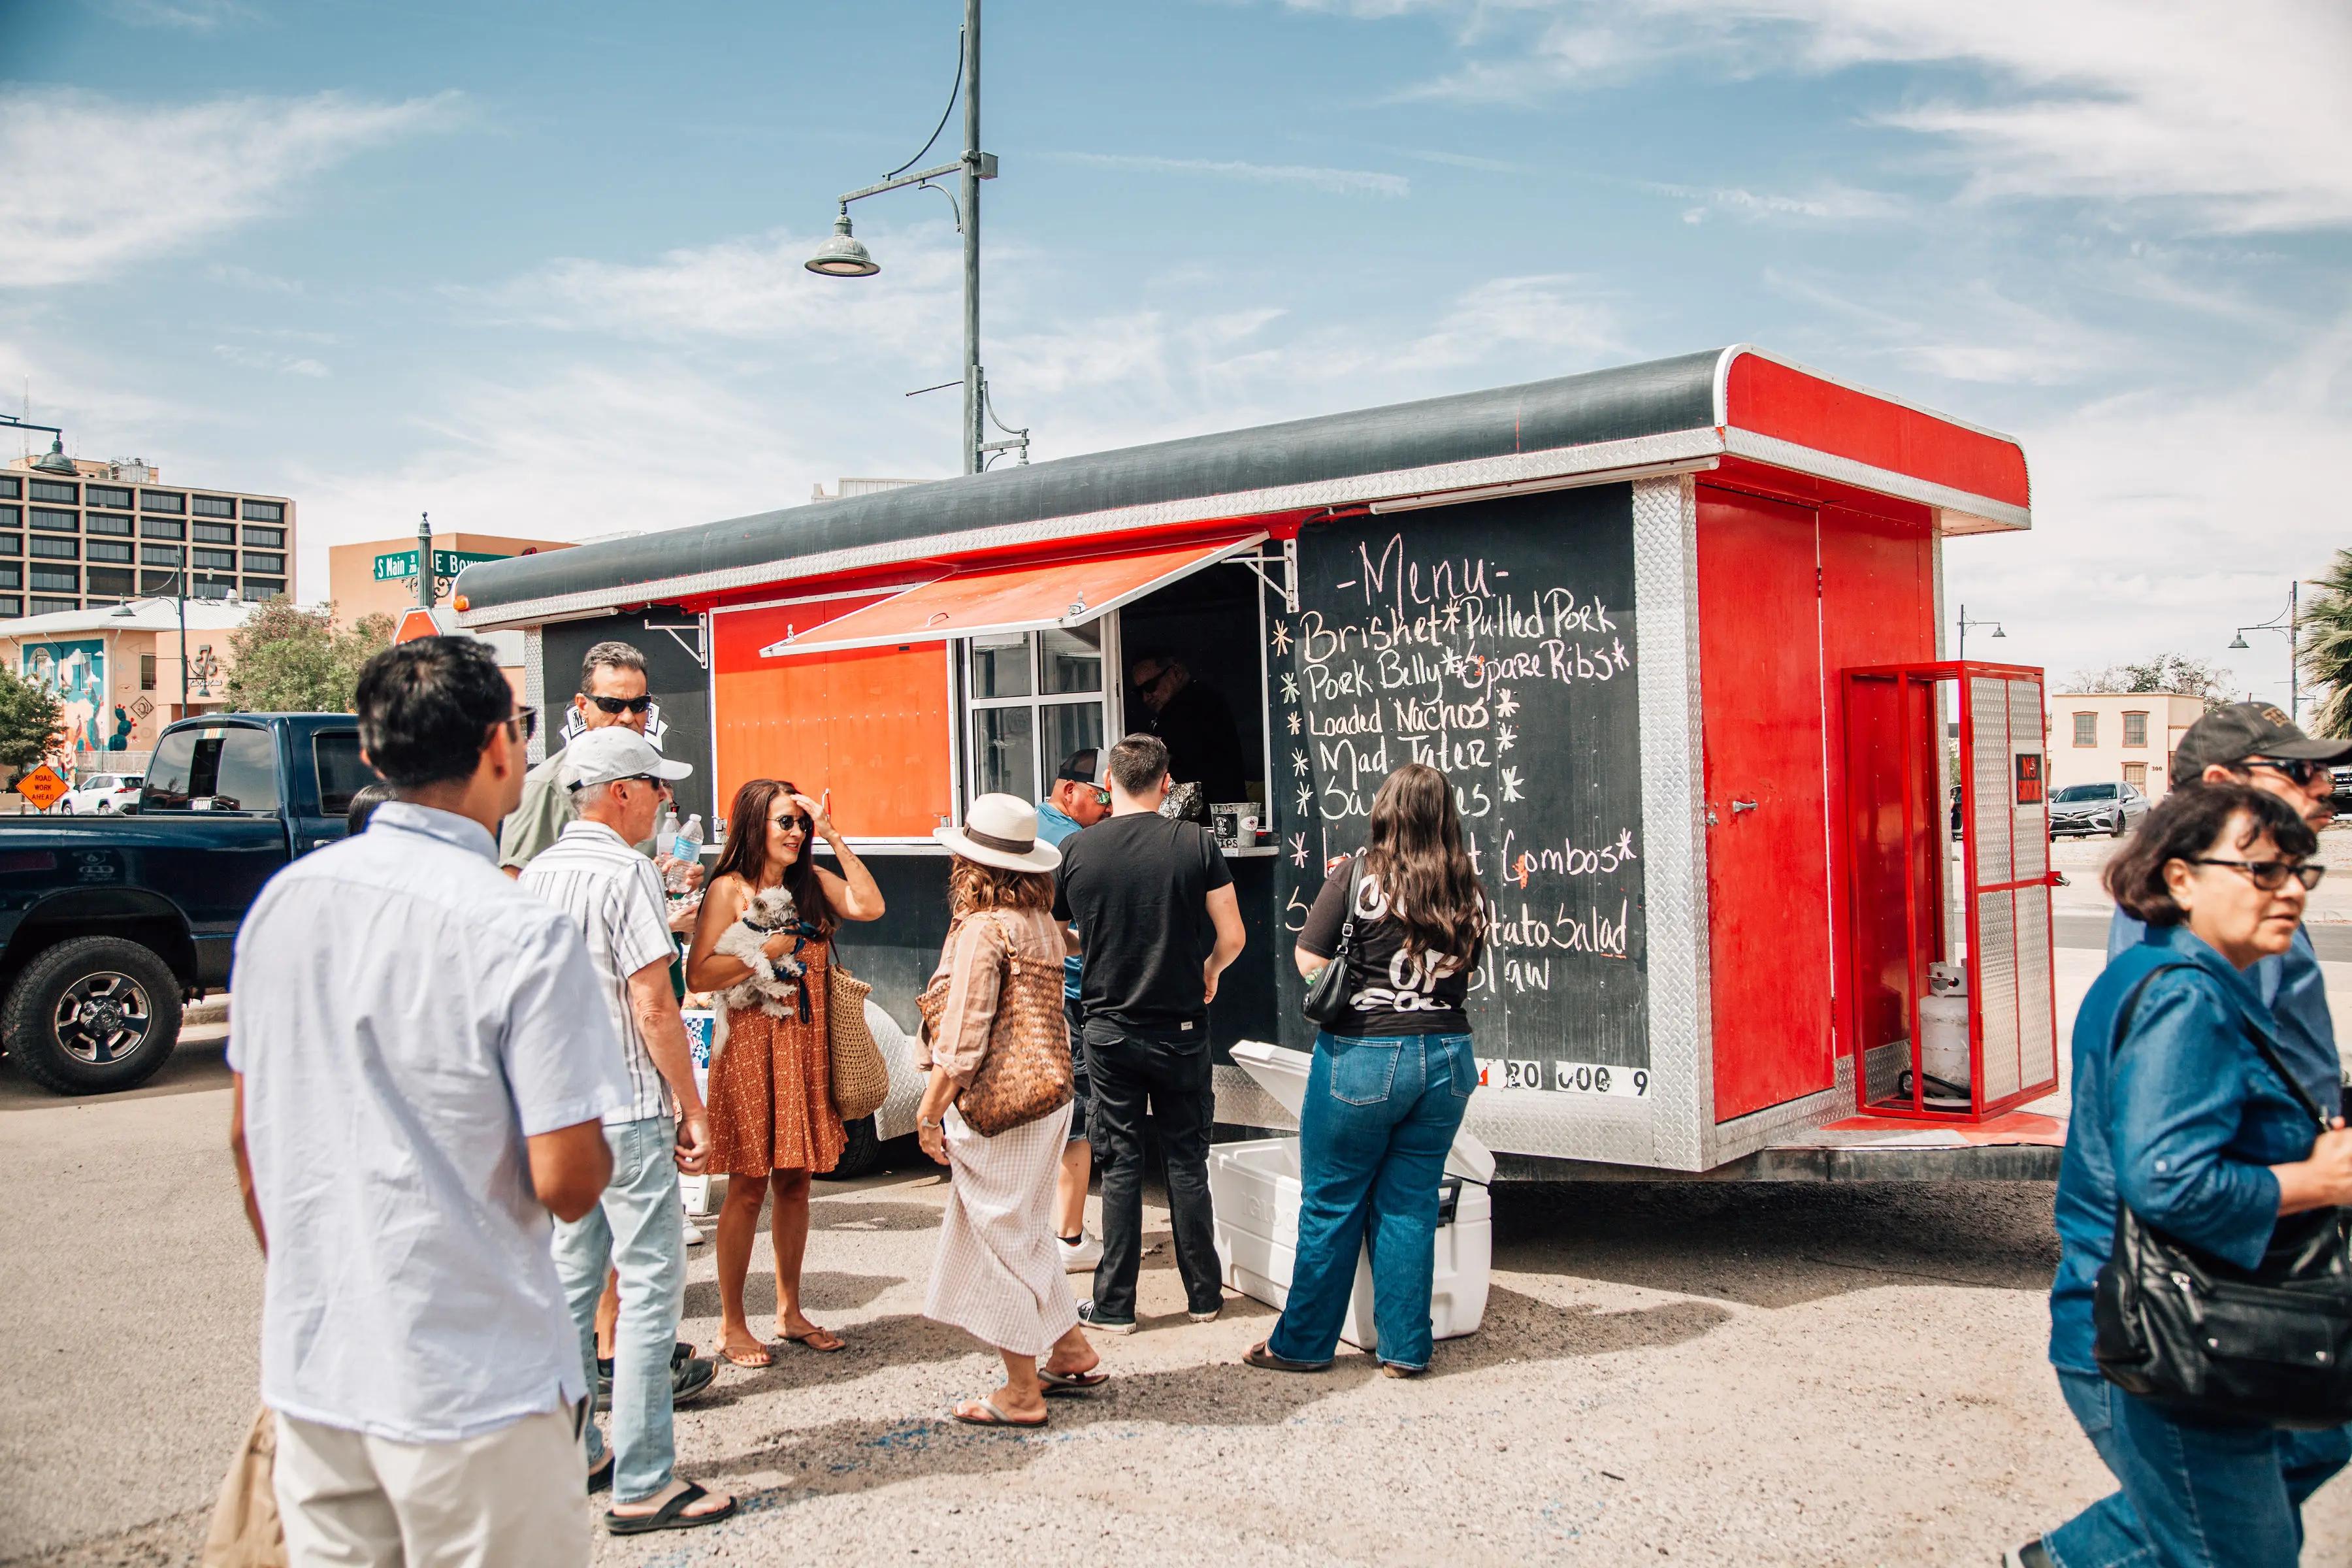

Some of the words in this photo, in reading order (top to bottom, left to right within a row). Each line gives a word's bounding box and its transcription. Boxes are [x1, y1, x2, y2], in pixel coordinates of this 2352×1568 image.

[378, 559, 384, 578] S
[386, 556, 405, 577] Main
[434, 553, 444, 573] E
[1459, 590, 1544, 640] Pulled
[1539, 639, 1613, 685] Ribs
[1309, 698, 1382, 736] Loaded
[1393, 696, 1490, 732] Nachos
[1319, 735, 1388, 791] Mad
[2022, 757, 2037, 778] NO
[1502, 829, 1620, 882] Combos
[1484, 899, 1550, 948] tato
[1551, 896, 1628, 955] Salad
[1633, 1070, 1648, 1096] 9
